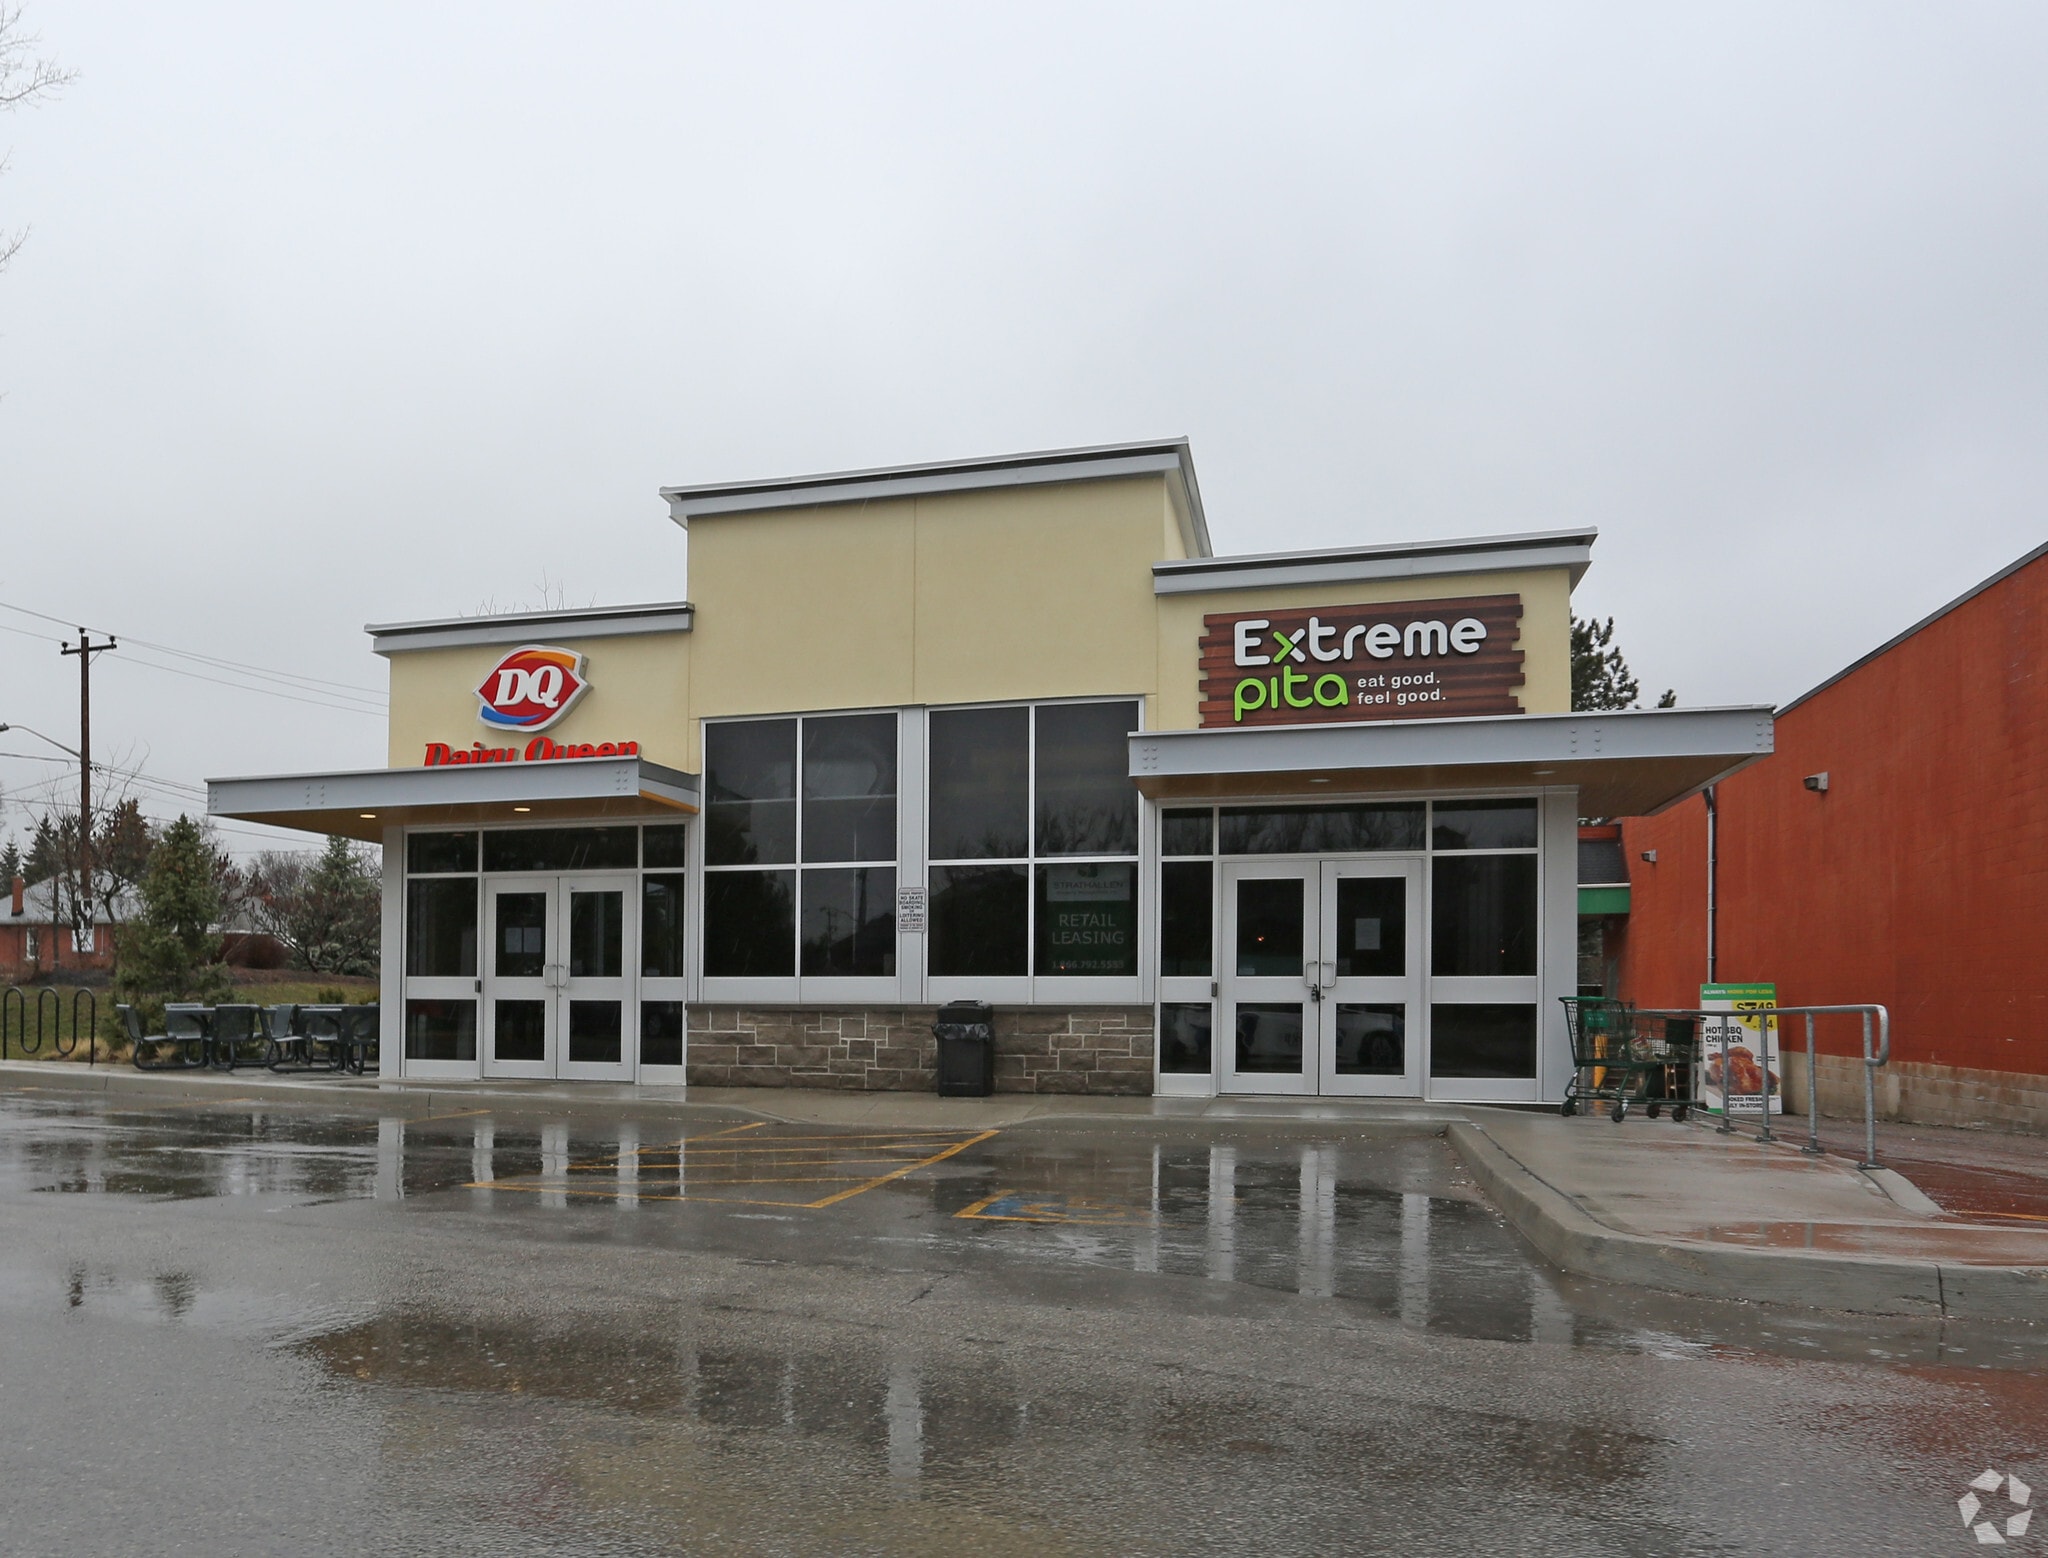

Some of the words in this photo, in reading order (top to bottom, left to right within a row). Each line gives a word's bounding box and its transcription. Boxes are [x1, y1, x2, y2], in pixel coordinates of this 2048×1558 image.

[1234, 616, 1487, 667] Extreme
[493, 665, 563, 708] DQ
[1357, 674, 1385, 688] eat
[1391, 671, 1440, 689] good.
[1234, 665, 1348, 721] pita
[1357, 691, 1390, 705] feel
[1396, 688, 1446, 706] good.
[1054, 881, 1123, 889] STRATHALLEN
[1059, 913, 1117, 927] RETAIL
[1052, 931, 1124, 945] LEASING
[1705, 1026, 1722, 1034] HOT
